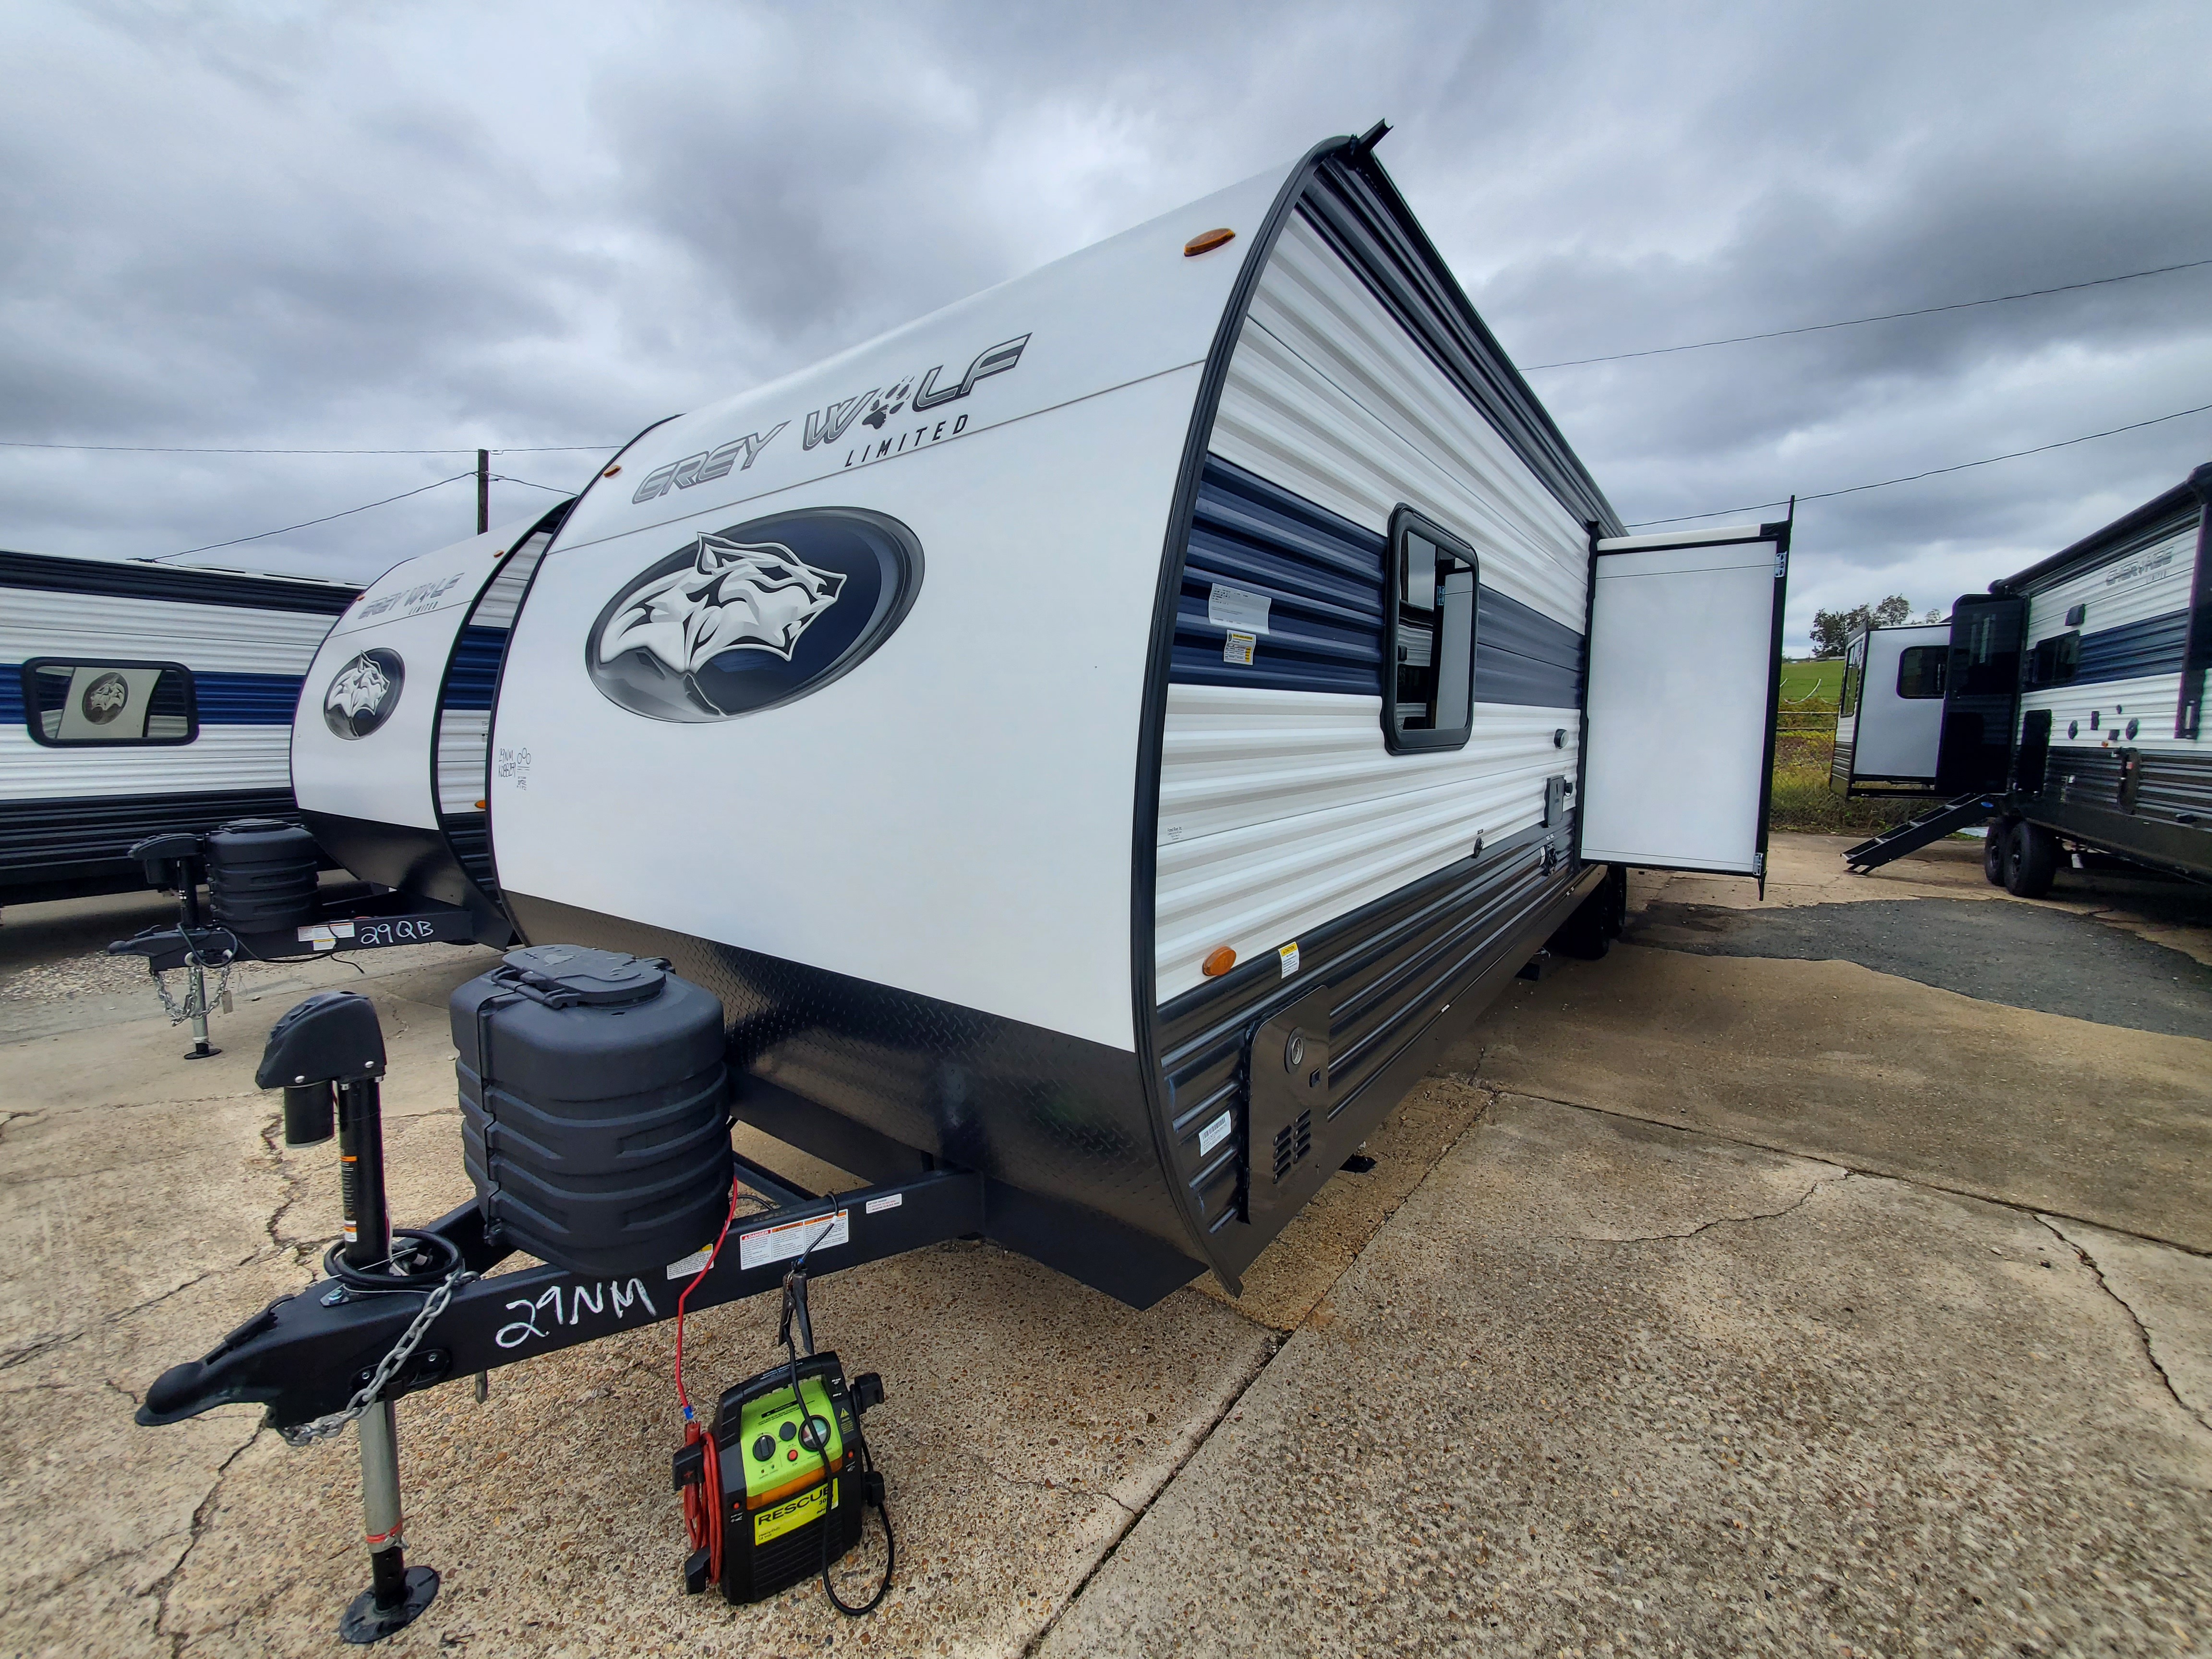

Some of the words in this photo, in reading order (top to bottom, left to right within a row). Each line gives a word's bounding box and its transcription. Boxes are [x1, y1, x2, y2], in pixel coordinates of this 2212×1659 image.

[844, 413, 969, 468] LIMITED
[631, 420, 792, 505] GREY
[358, 589, 410, 619] GREY
[408, 601, 439, 615] LIMITED
[360, 920, 434, 944] 29QB
[748, 1230, 769, 1238] DANGER
[495, 1277, 657, 1348] 29NM
